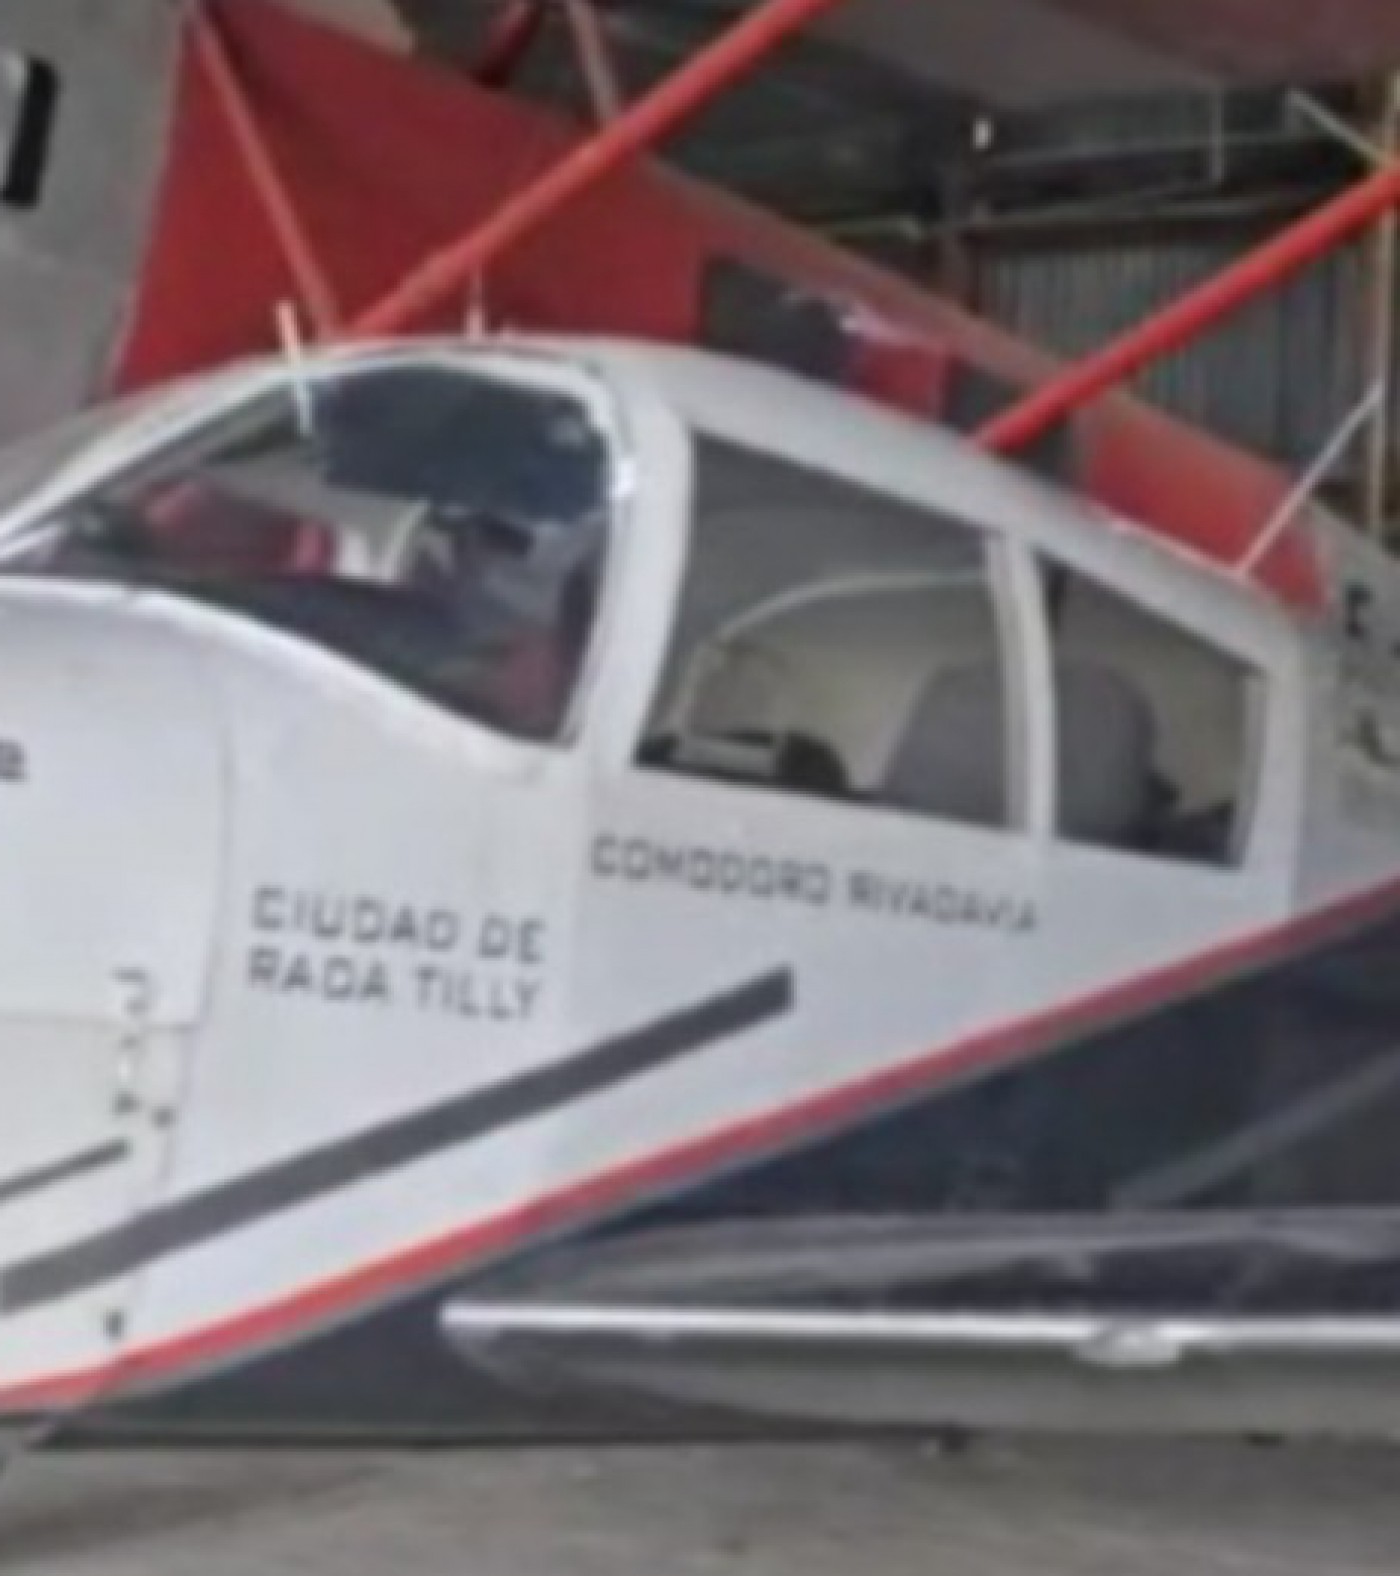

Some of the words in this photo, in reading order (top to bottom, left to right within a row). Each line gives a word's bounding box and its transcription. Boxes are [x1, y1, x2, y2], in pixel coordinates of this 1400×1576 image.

[591, 835, 830, 905] COMODORO
[253, 886, 459, 951] CIUDAD
[478, 913, 546, 964] DE
[249, 947, 389, 1001] RADA
[413, 964, 542, 1020] TILLY
